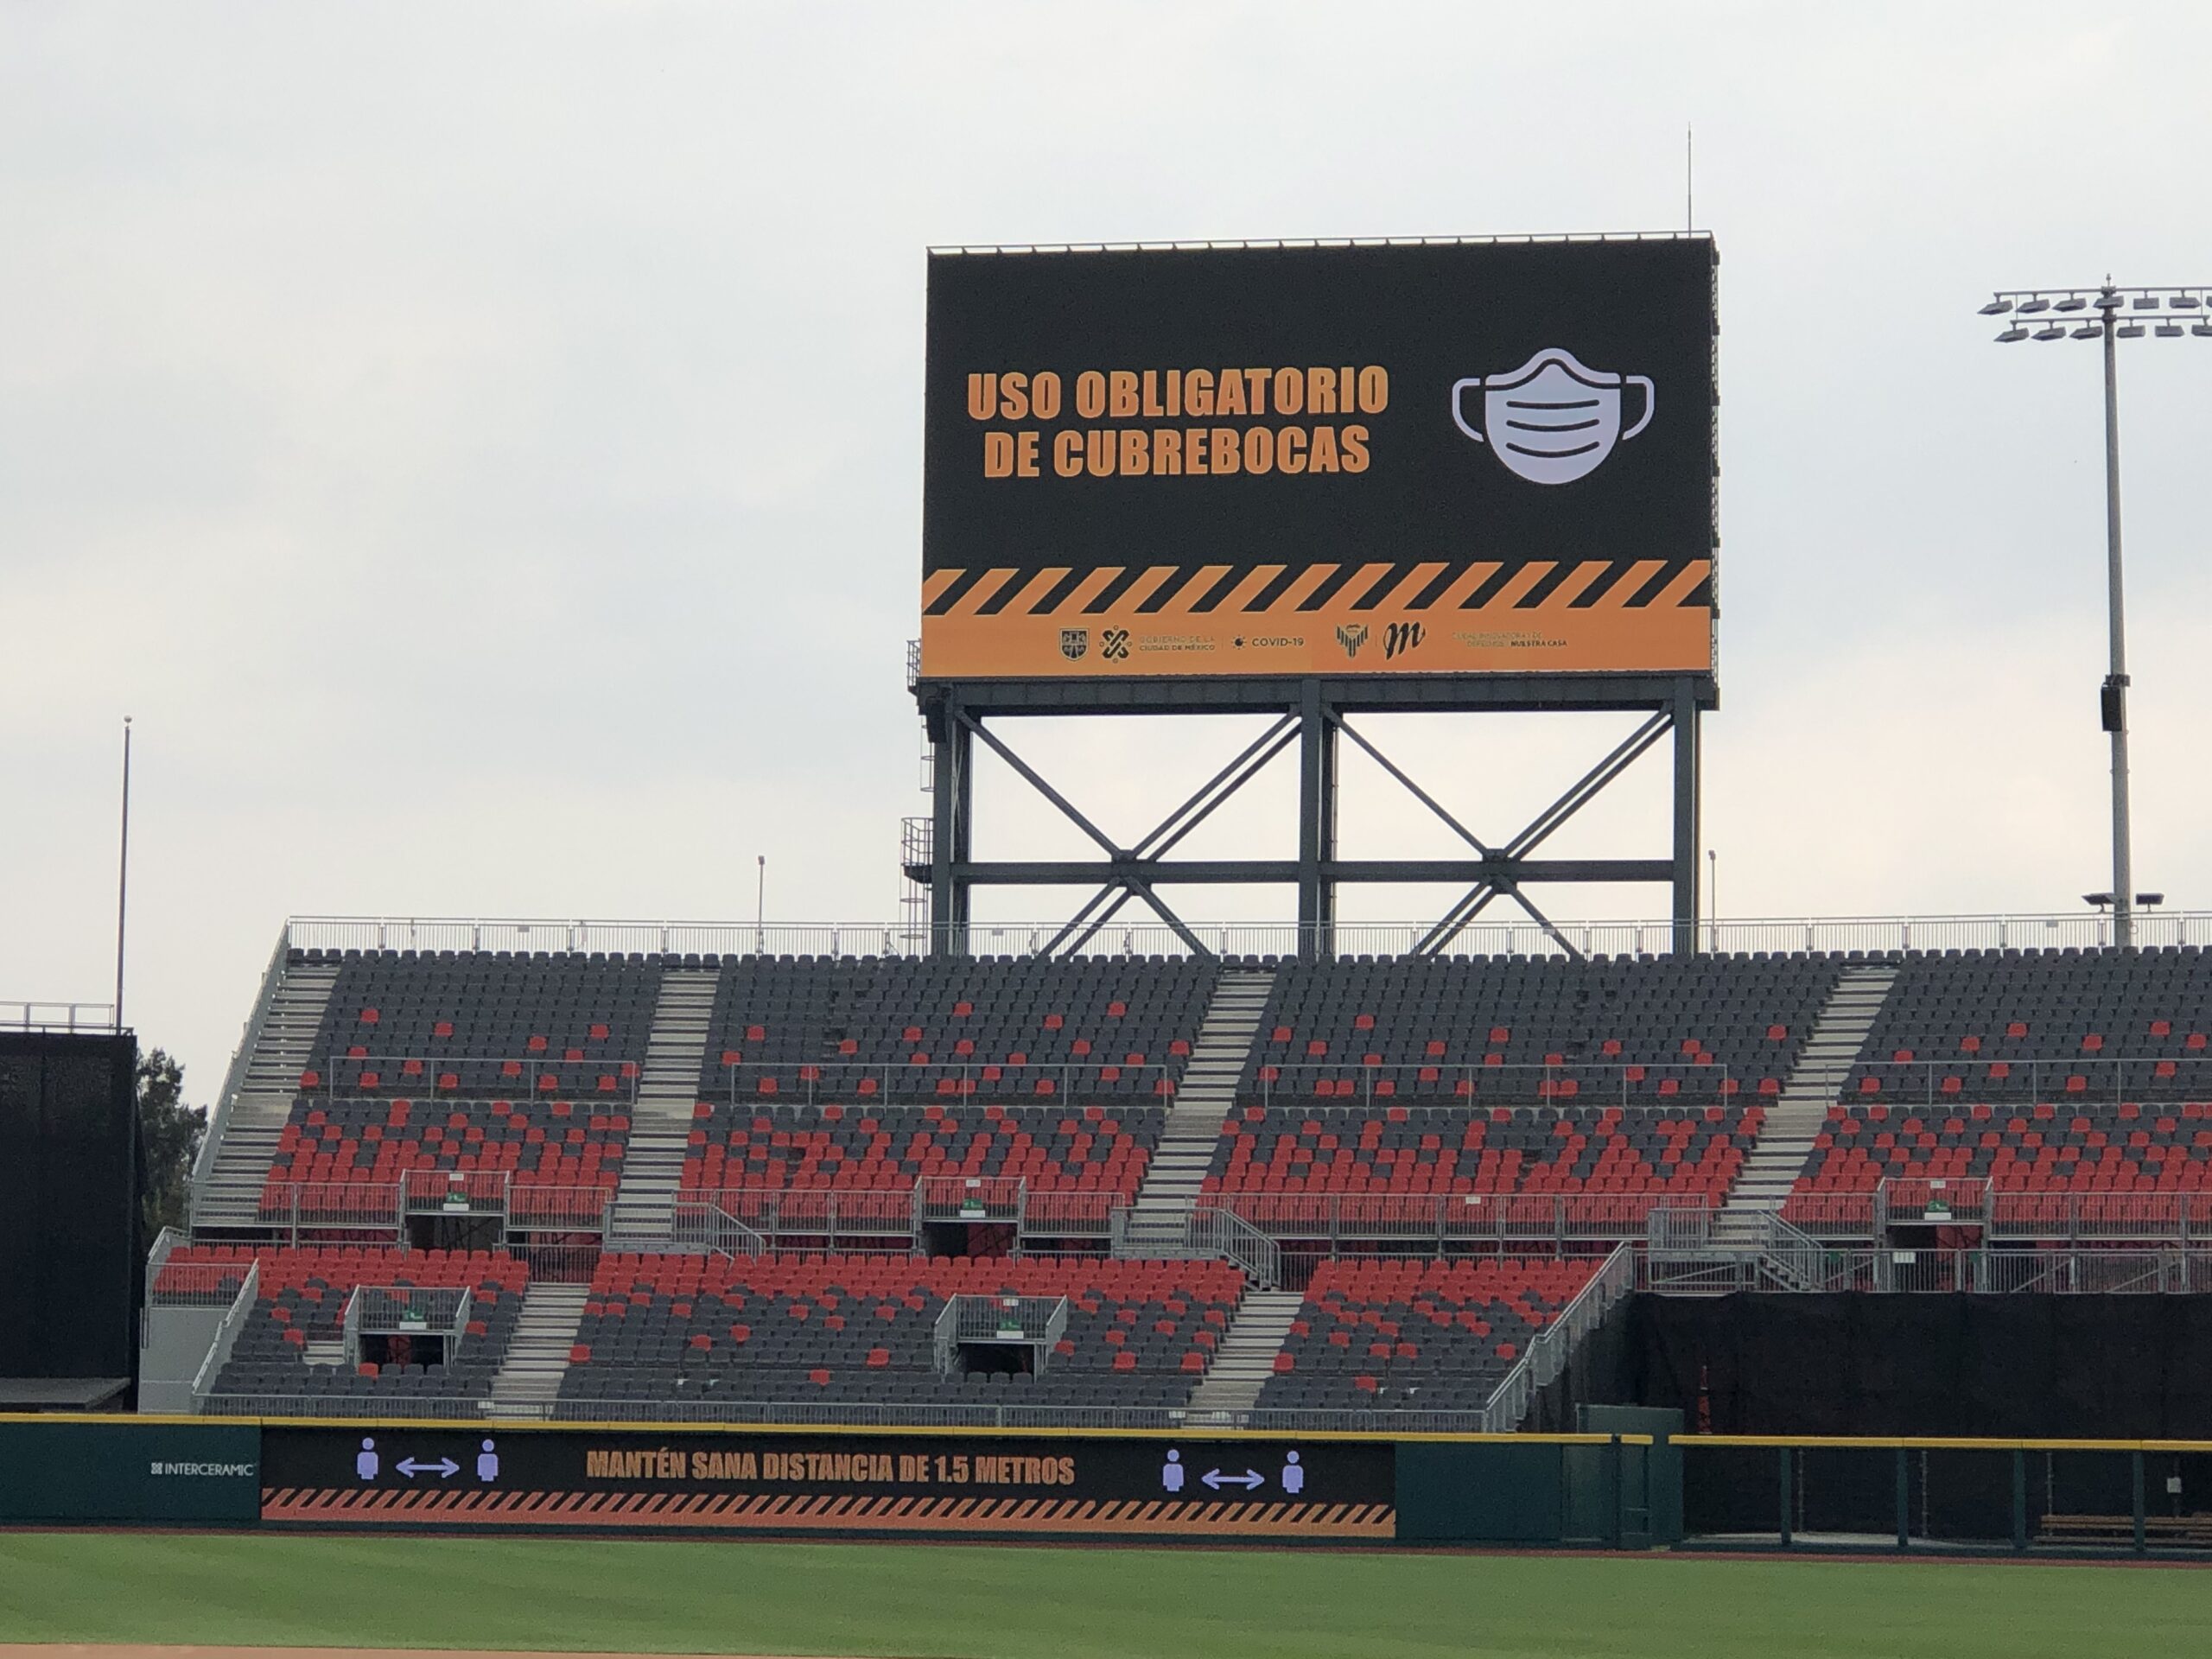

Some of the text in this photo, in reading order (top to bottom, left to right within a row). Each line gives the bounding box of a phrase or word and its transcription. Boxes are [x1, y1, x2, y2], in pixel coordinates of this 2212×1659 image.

[968, 365, 1389, 421] USO OBLIGATORIO
[984, 424, 1370, 478] DE CUBREBOCAS
[1251, 637, 1305, 647] COVID-19
[164, 1462, 254, 1477] INTERCERAMIC
[587, 1446, 1075, 1484] MANTÉN SANA DISTANCIA DE 1.5 METROS
